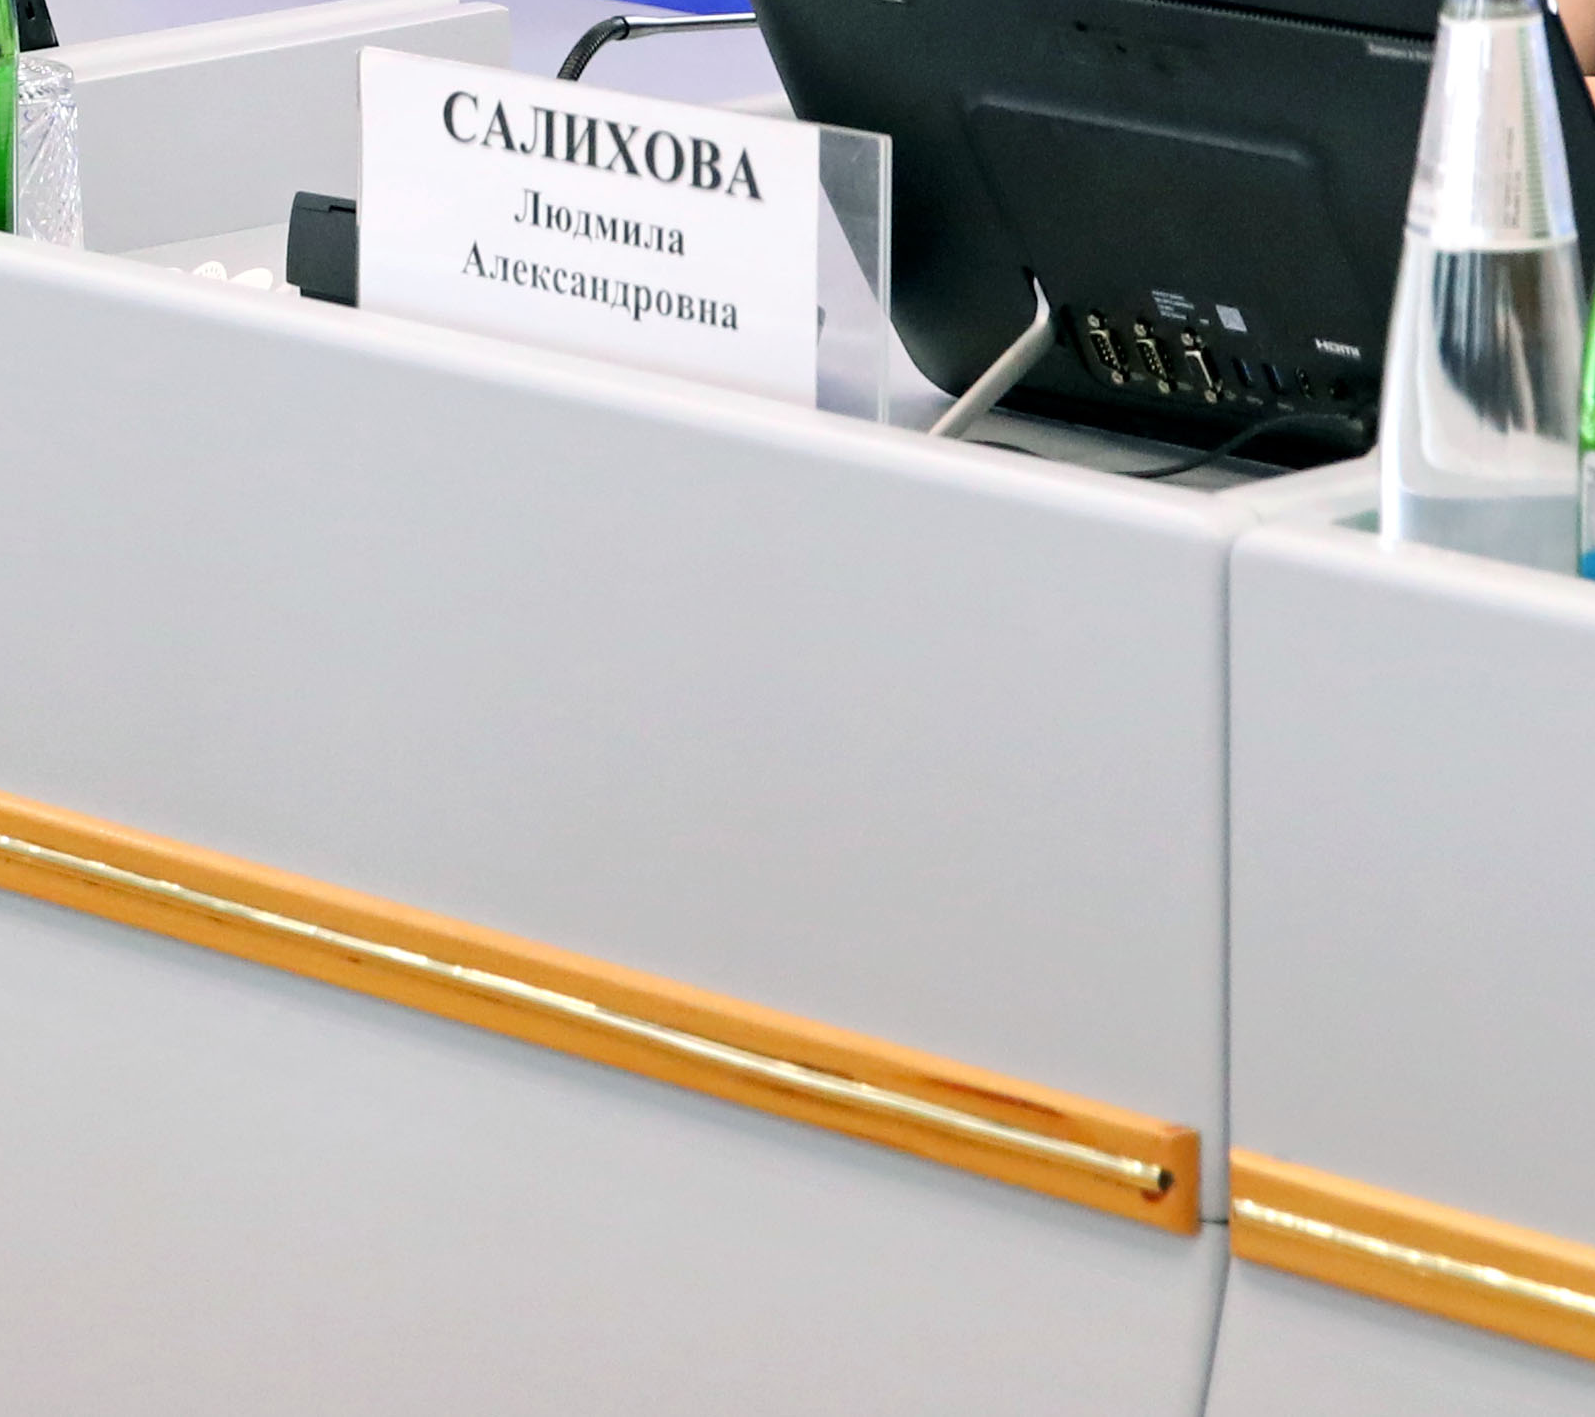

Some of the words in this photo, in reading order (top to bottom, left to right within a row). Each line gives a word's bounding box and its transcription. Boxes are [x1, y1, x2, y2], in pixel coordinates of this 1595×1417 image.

[442, 90, 763, 202] САЛИХОВА
[514, 188, 686, 257] Людмила
[462, 240, 739, 331] Александровна
